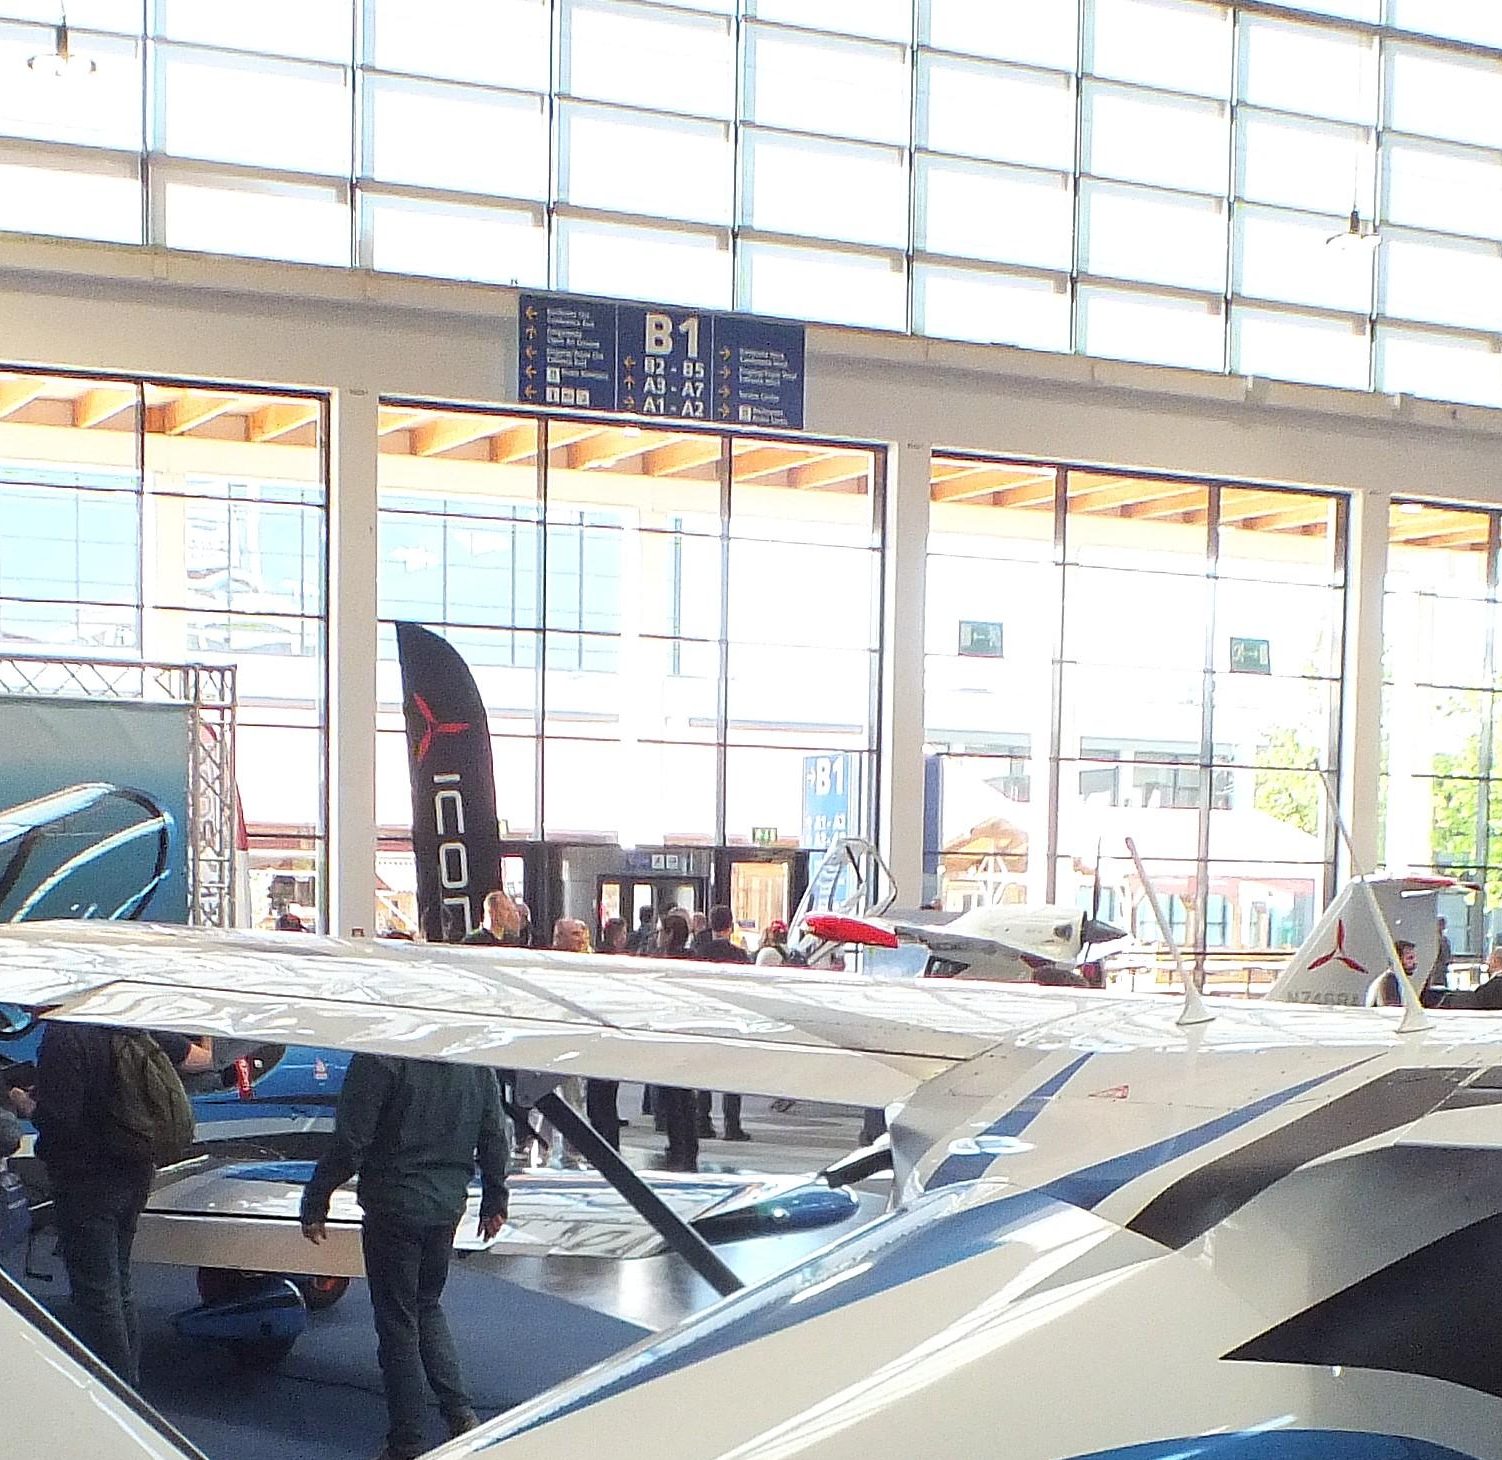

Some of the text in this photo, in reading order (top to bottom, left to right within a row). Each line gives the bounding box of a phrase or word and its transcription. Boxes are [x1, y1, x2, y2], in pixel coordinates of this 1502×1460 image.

[644, 311, 699, 358] B1
[644, 356, 665, 375] B2
[683, 360, 705, 378] B5
[682, 380, 705, 398] A7
[643, 396, 665, 414] A1
[682, 400, 704, 417] A2
[814, 756, 845, 796] B1
